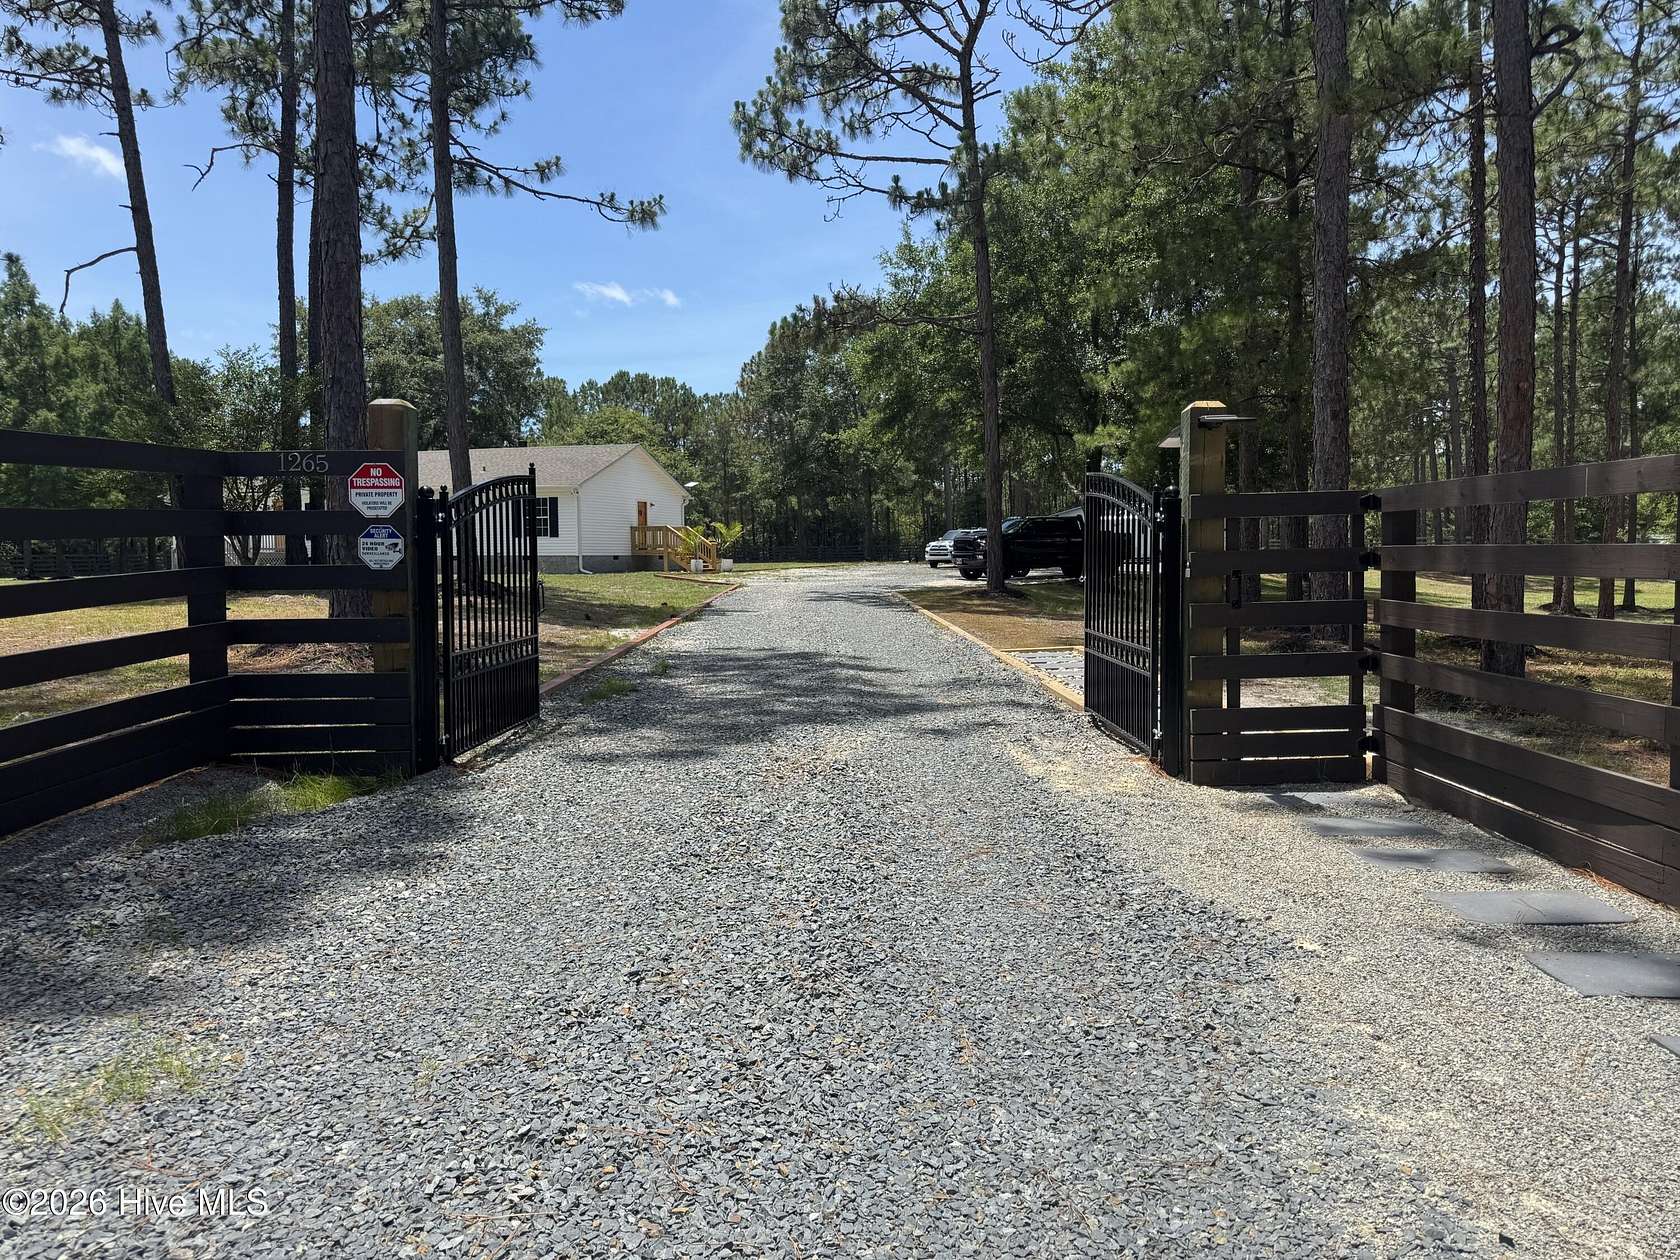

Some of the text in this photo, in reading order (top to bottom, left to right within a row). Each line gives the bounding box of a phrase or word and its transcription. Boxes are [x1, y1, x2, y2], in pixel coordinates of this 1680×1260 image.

[278, 452, 329, 473] 1265
[370, 467, 382, 477] NO
[352, 477, 401, 487] TRESPASSING
